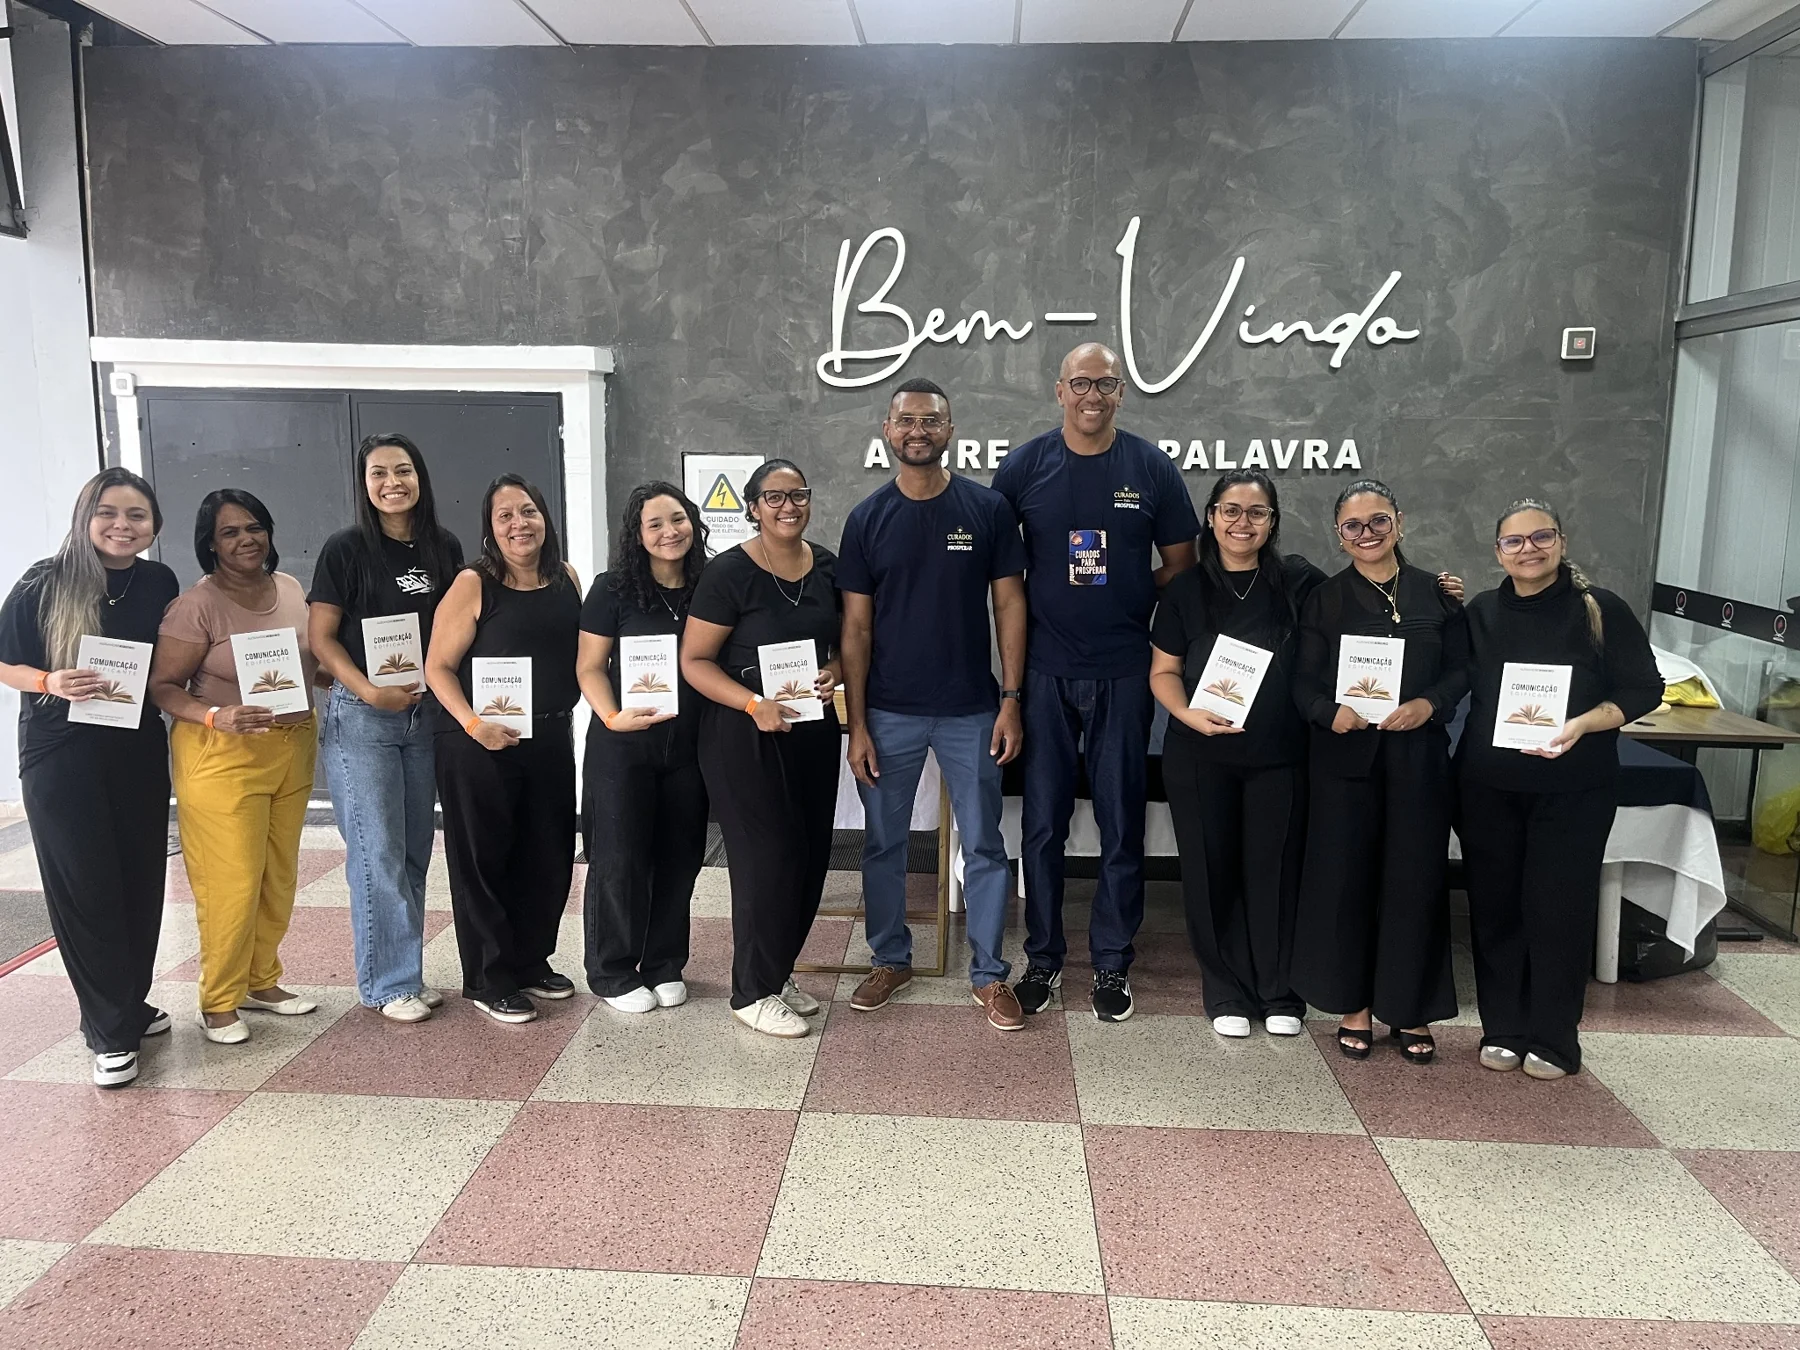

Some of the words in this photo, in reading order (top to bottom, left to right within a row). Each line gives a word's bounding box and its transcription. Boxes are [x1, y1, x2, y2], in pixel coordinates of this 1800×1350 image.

[1157, 439, 1362, 470] PALAVRA
[1113, 491, 1140, 499] CURADOS
[1114, 502, 1140, 510] PROSPERAR
[1075, 550, 1100, 559] CURADOS
[1081, 558, 1096, 567] PARA
[1075, 565, 1107, 575] PROSPERAR
[373, 632, 413, 644] COMUNICAÇÃO
[244, 648, 289, 660] COMUNICAÇÃO
[628, 653, 667, 662] COMUNICAÇÃO
[89, 657, 138, 670] COMUNICAÇÃO
[769, 659, 808, 671] COMUNICAÇÃO
[1349, 655, 1393, 666] COMUNICAÇÃO
[481, 676, 522, 684] COMUNICAÇÃO
[1511, 683, 1558, 693] COMUNICAÇÃO
